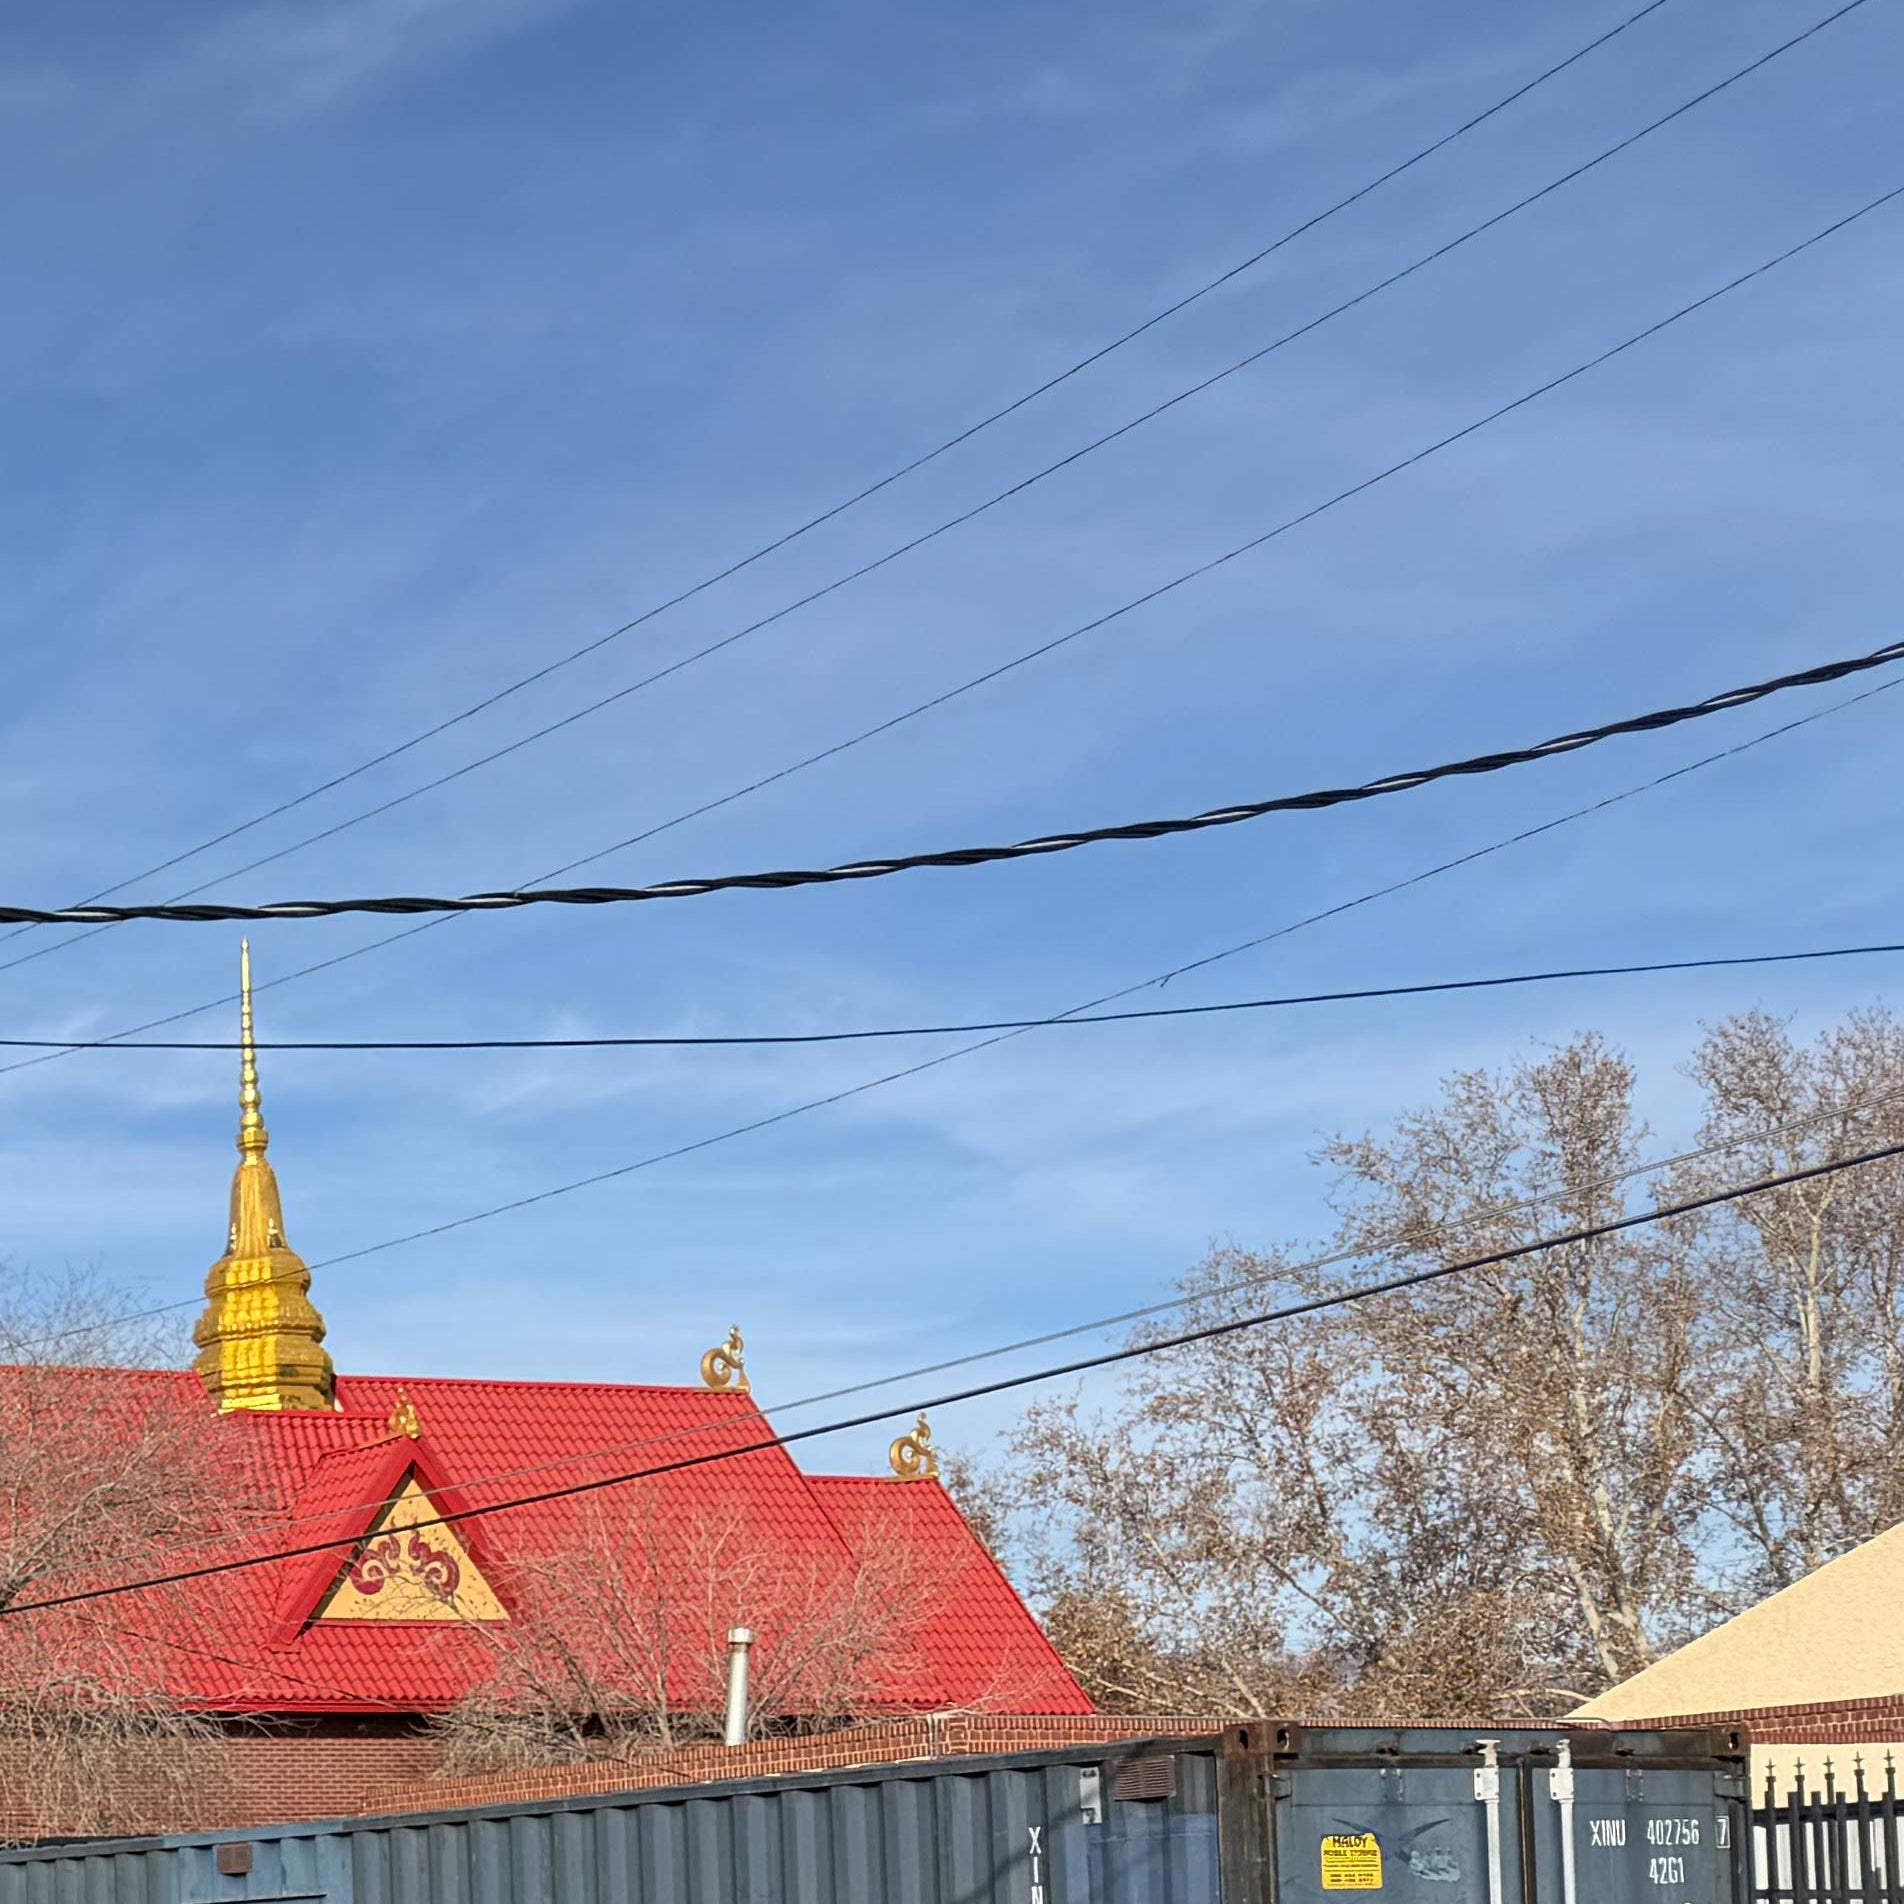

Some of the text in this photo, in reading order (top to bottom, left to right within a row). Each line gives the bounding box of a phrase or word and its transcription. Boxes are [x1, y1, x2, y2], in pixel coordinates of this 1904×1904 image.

[1589, 1819, 1728, 1847] XINU 402756 7
[1648, 1856, 1685, 1885] 42G1
